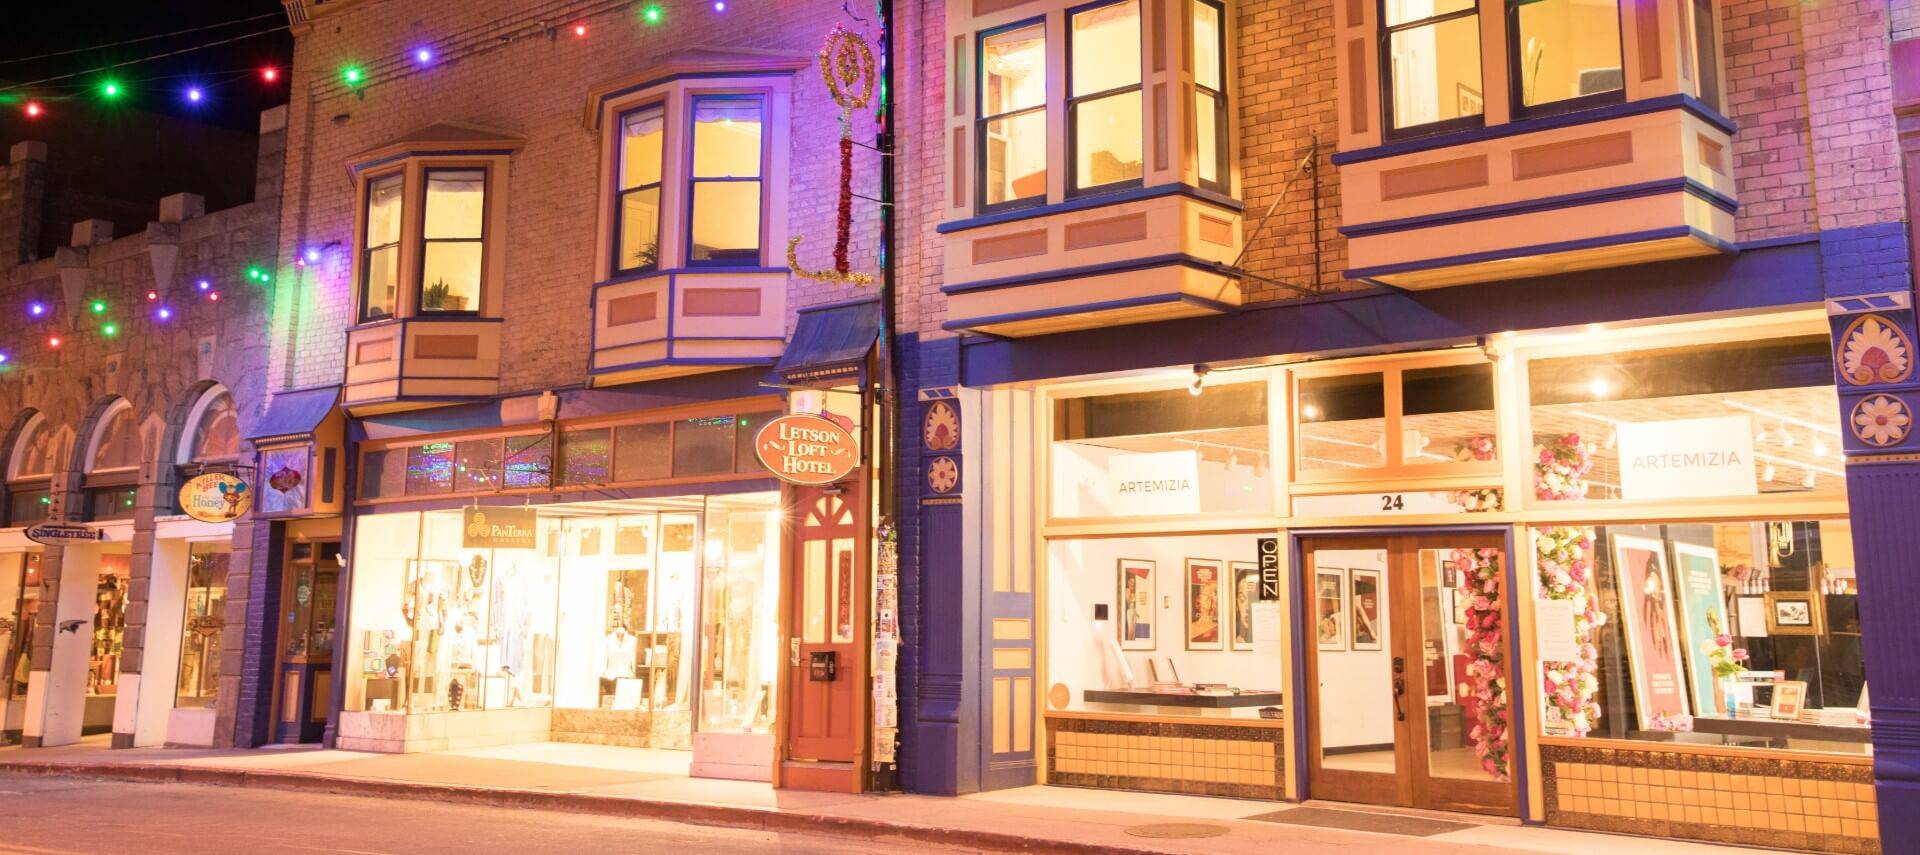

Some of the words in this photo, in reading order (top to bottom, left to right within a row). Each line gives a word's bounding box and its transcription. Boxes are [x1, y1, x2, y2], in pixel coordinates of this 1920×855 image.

[780, 423, 840, 443] LETSON
[789, 440, 828, 457] LOFT
[782, 456, 836, 474] HOTEL
[1631, 451, 1742, 470] ARTEMIZIA
[196, 474, 225, 489] KILLER
[1119, 479, 1190, 494] ARTEMIZIA
[193, 495, 225, 510] Honey
[1382, 494, 1404, 511] 24
[32, 528, 96, 540] SINGLETREE
[1261, 540, 1278, 598] OPEN
